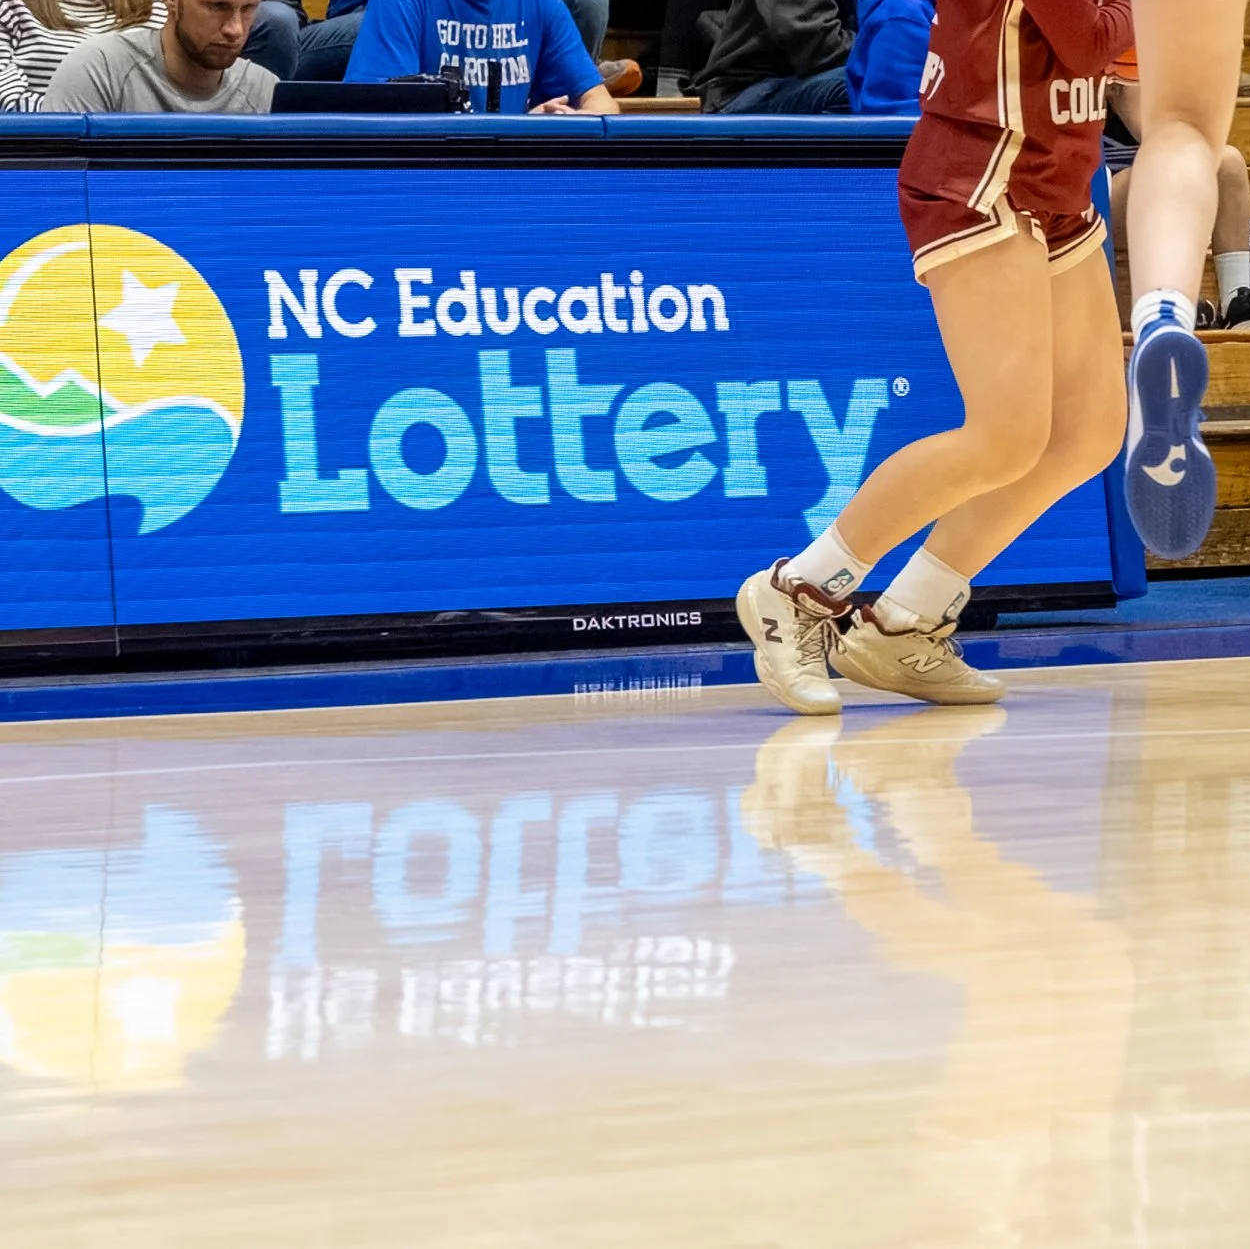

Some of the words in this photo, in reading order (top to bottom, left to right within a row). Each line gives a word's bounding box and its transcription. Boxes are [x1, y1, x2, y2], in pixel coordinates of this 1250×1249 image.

[436, 18, 460, 47] GO
[462, 23, 488, 49] TO
[263, 267, 378, 340] NC
[394, 267, 730, 338] Education
[572, 611, 702, 632] DAKTRONICS
